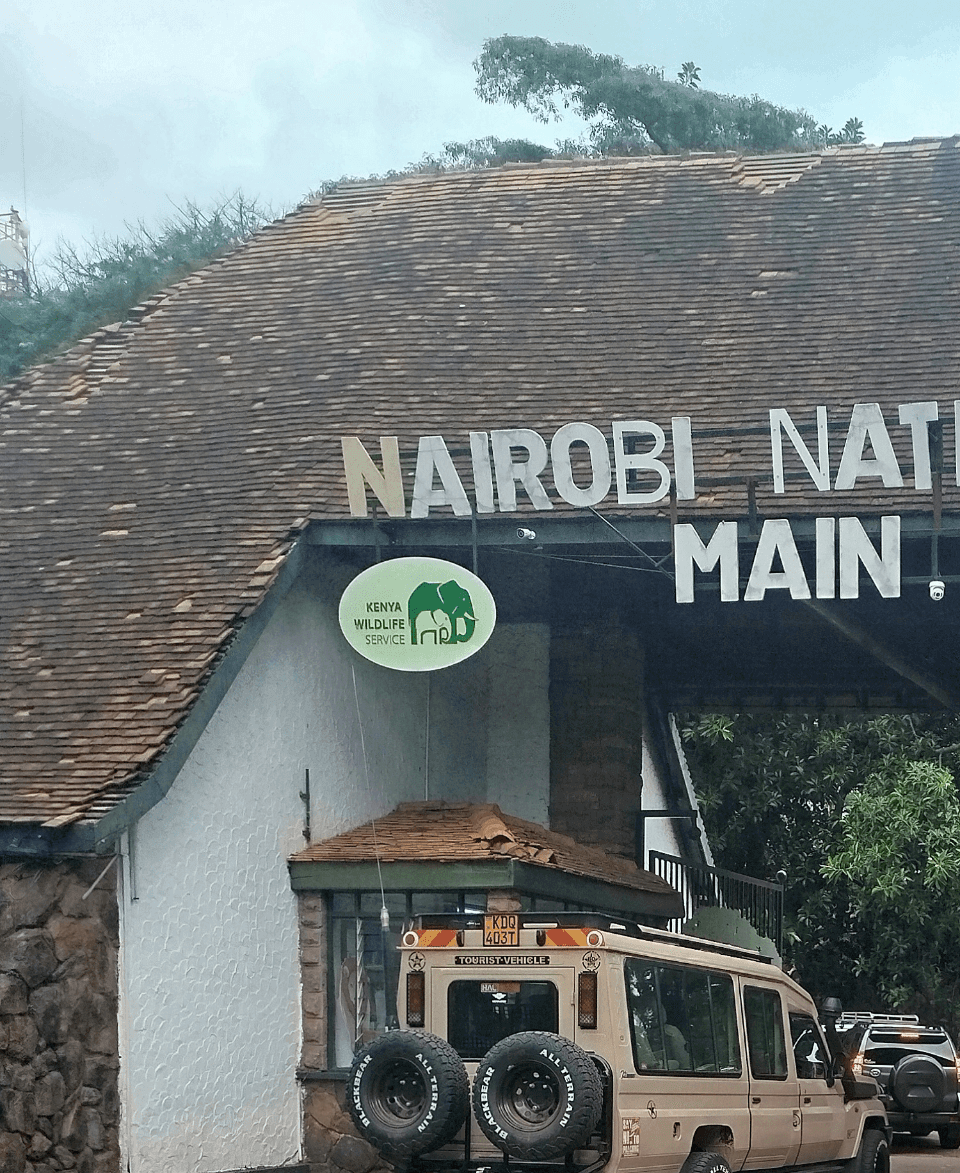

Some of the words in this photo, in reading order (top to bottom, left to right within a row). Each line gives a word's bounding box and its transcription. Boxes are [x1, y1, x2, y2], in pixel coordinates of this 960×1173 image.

[341, 416, 696, 518] NAIROBI
[674, 515, 901, 603] MAIN
[354, 618, 405, 630] WILDLIFE
[366, 601, 402, 612] KENYA
[365, 634, 405, 645] SERVICE
[486, 931, 516, 945] 403T
[492, 915, 516, 930] KDQ
[415, 1053, 433, 1075] ALL
[353, 1054, 373, 1127] BLACKBEAR
[417, 1075, 439, 1133] TERRAIN
[480, 1066, 509, 1140] BLACKBEAR
[540, 1049, 561, 1067] ALL
[559, 1066, 575, 1128] TERRAIN
